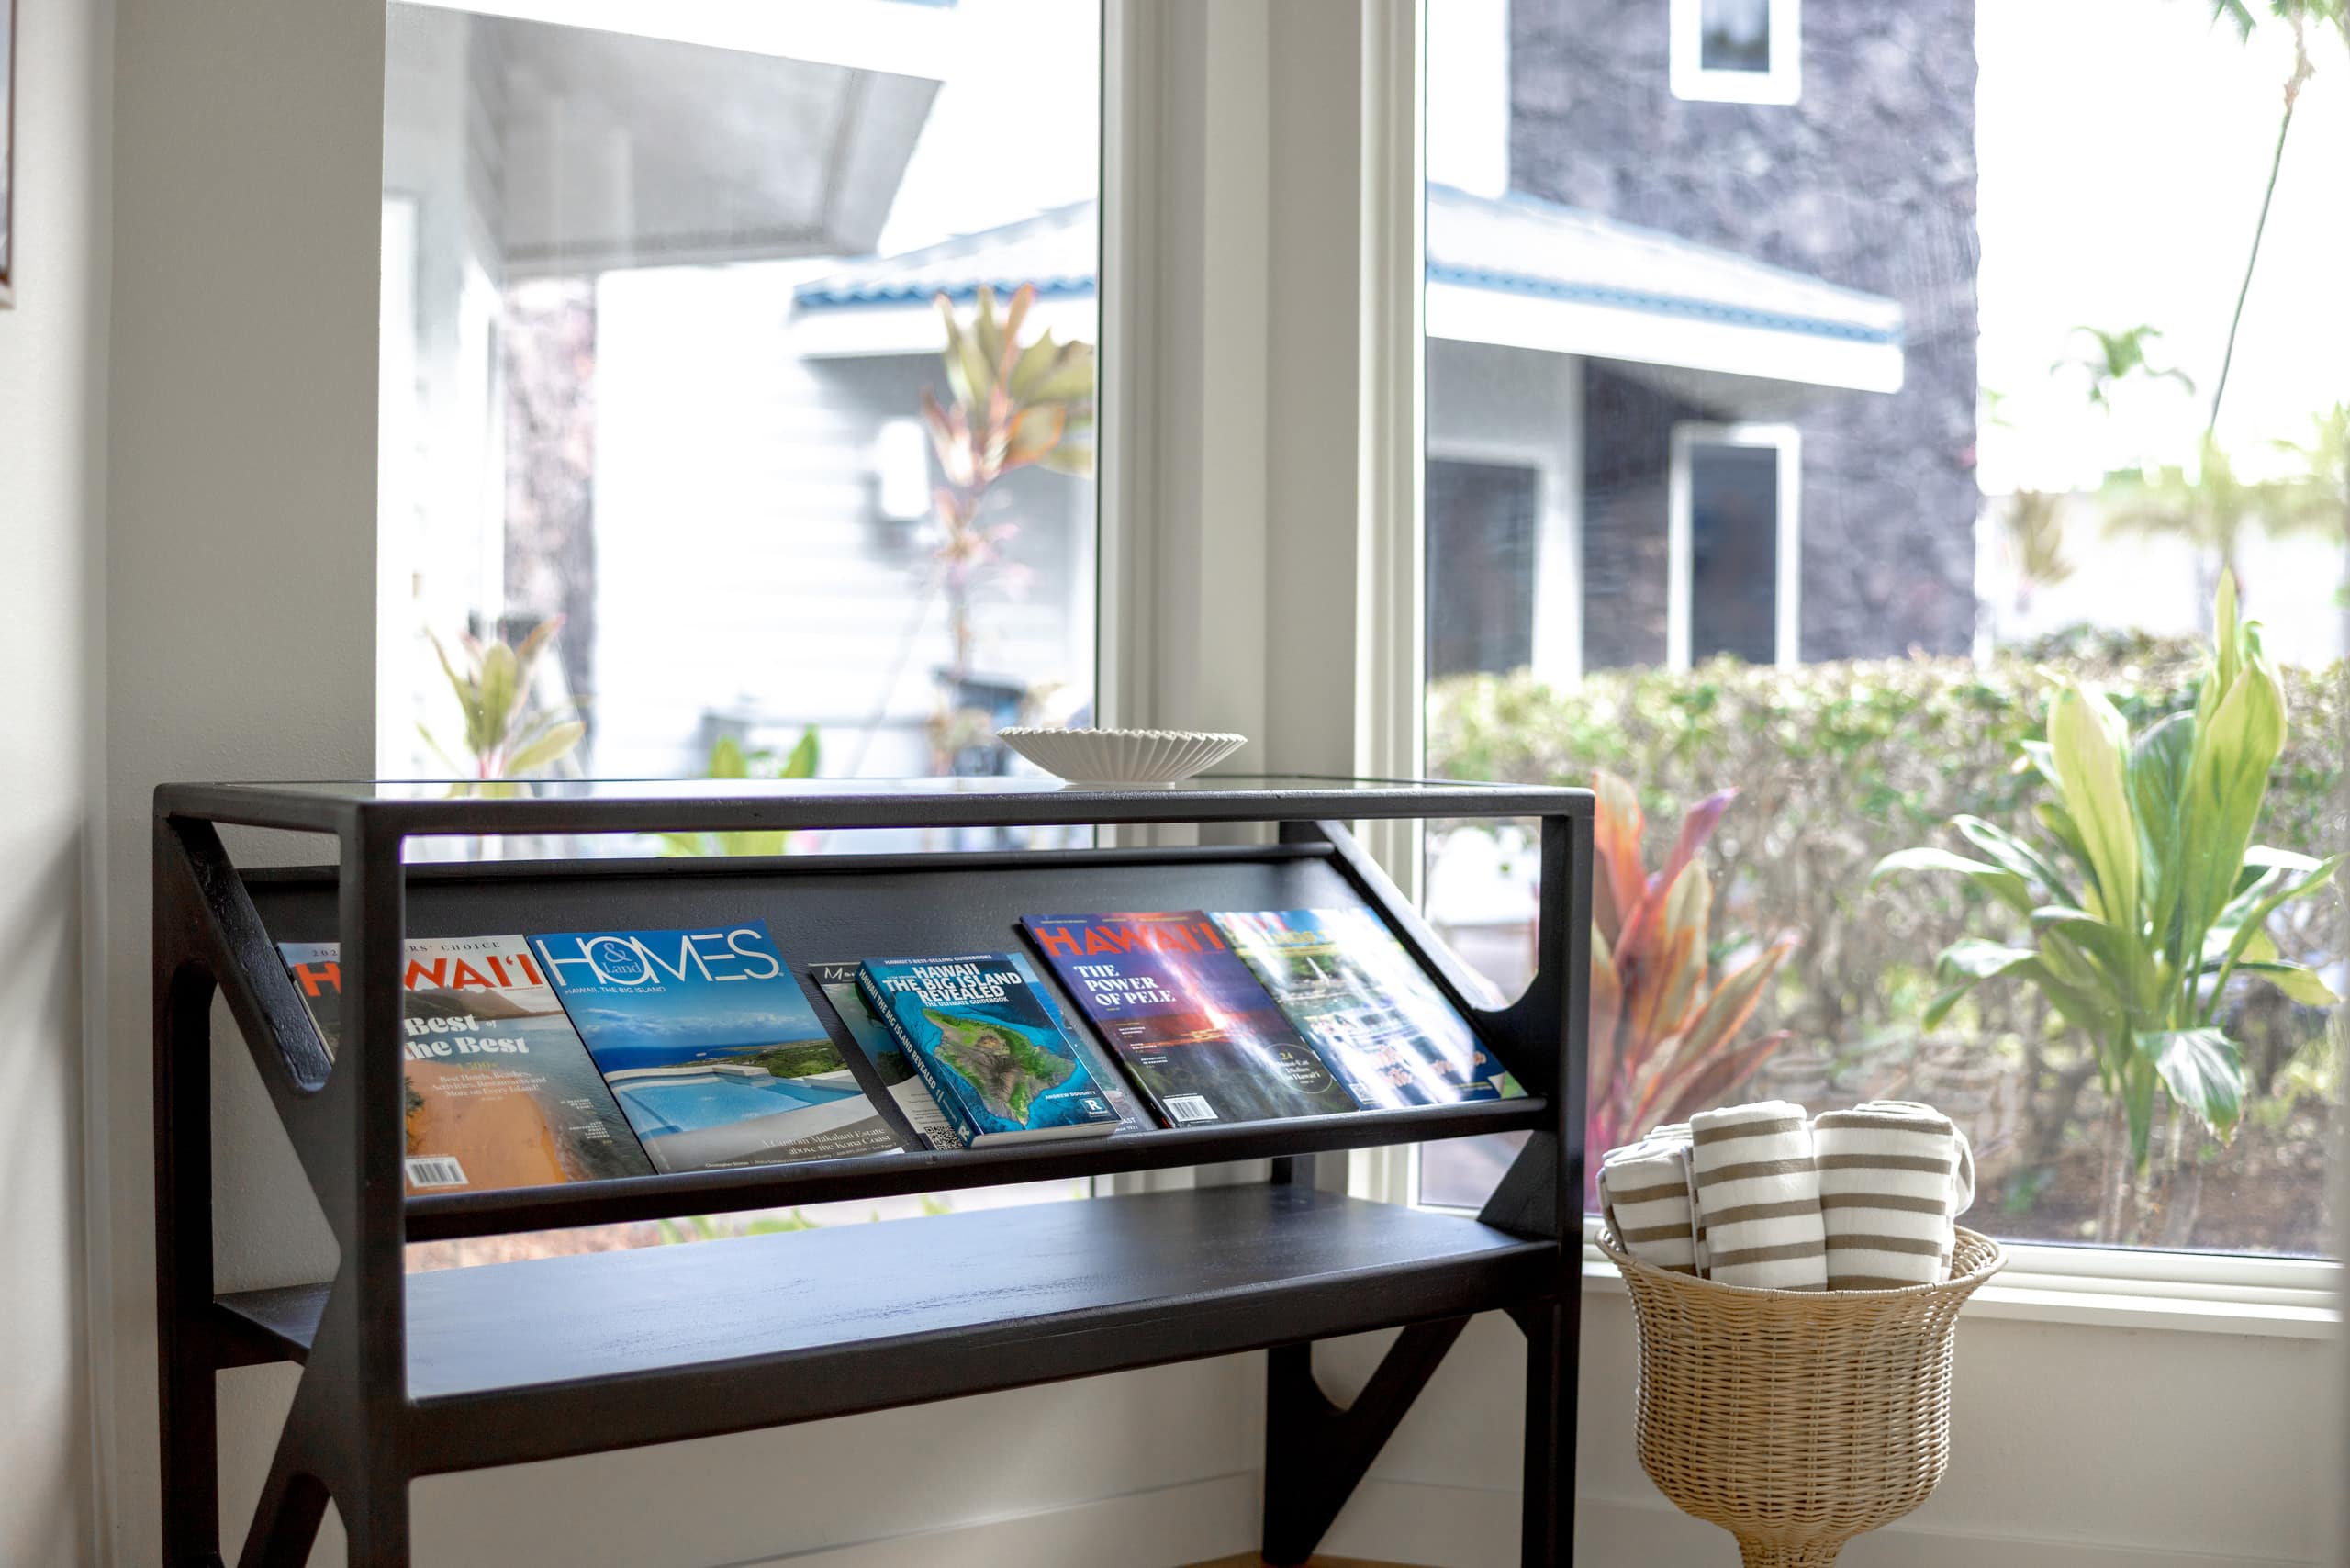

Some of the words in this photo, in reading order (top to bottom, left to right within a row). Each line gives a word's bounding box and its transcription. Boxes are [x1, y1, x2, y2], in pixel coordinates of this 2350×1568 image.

[441, 941, 500, 951] CHOICE
[1035, 922, 1226, 957] HAWAI'I
[535, 929, 779, 986] HOMES
[294, 953, 543, 997] HWAI'I
[603, 961, 643, 974] Land
[912, 963, 980, 979] HAWAII
[1073, 964, 1120, 978] THE
[635, 986, 666, 994] ISLAND
[882, 979, 922, 992] THE
[921, 977, 957, 991] BIG
[956, 972, 1023, 989] ISLAND
[1084, 976, 1159, 992] POWER
[916, 985, 1005, 1002] REVEALED
[969, 996, 1009, 1004] GUIDEBOOK
[1094, 993, 1122, 1007] OF
[1124, 990, 1177, 1004] PELE
[404, 1014, 479, 1036] Best
[485, 1020, 498, 1029] of
[859, 969, 878, 999] HAWAII
[876, 995, 888, 1014] THE
[885, 1010, 897, 1028] BIG
[894, 1024, 915, 1053] ISLAND
[912, 1050, 937, 1090] REVEALED
[454, 1036, 530, 1054] Best
[810, 1130, 855, 1144] Makalani
[855, 1127, 886, 1138] Estate
[788, 1147, 816, 1155] above
[818, 1143, 834, 1151] the
[835, 1140, 862, 1149] Kona
[862, 1135, 891, 1146] Coast
